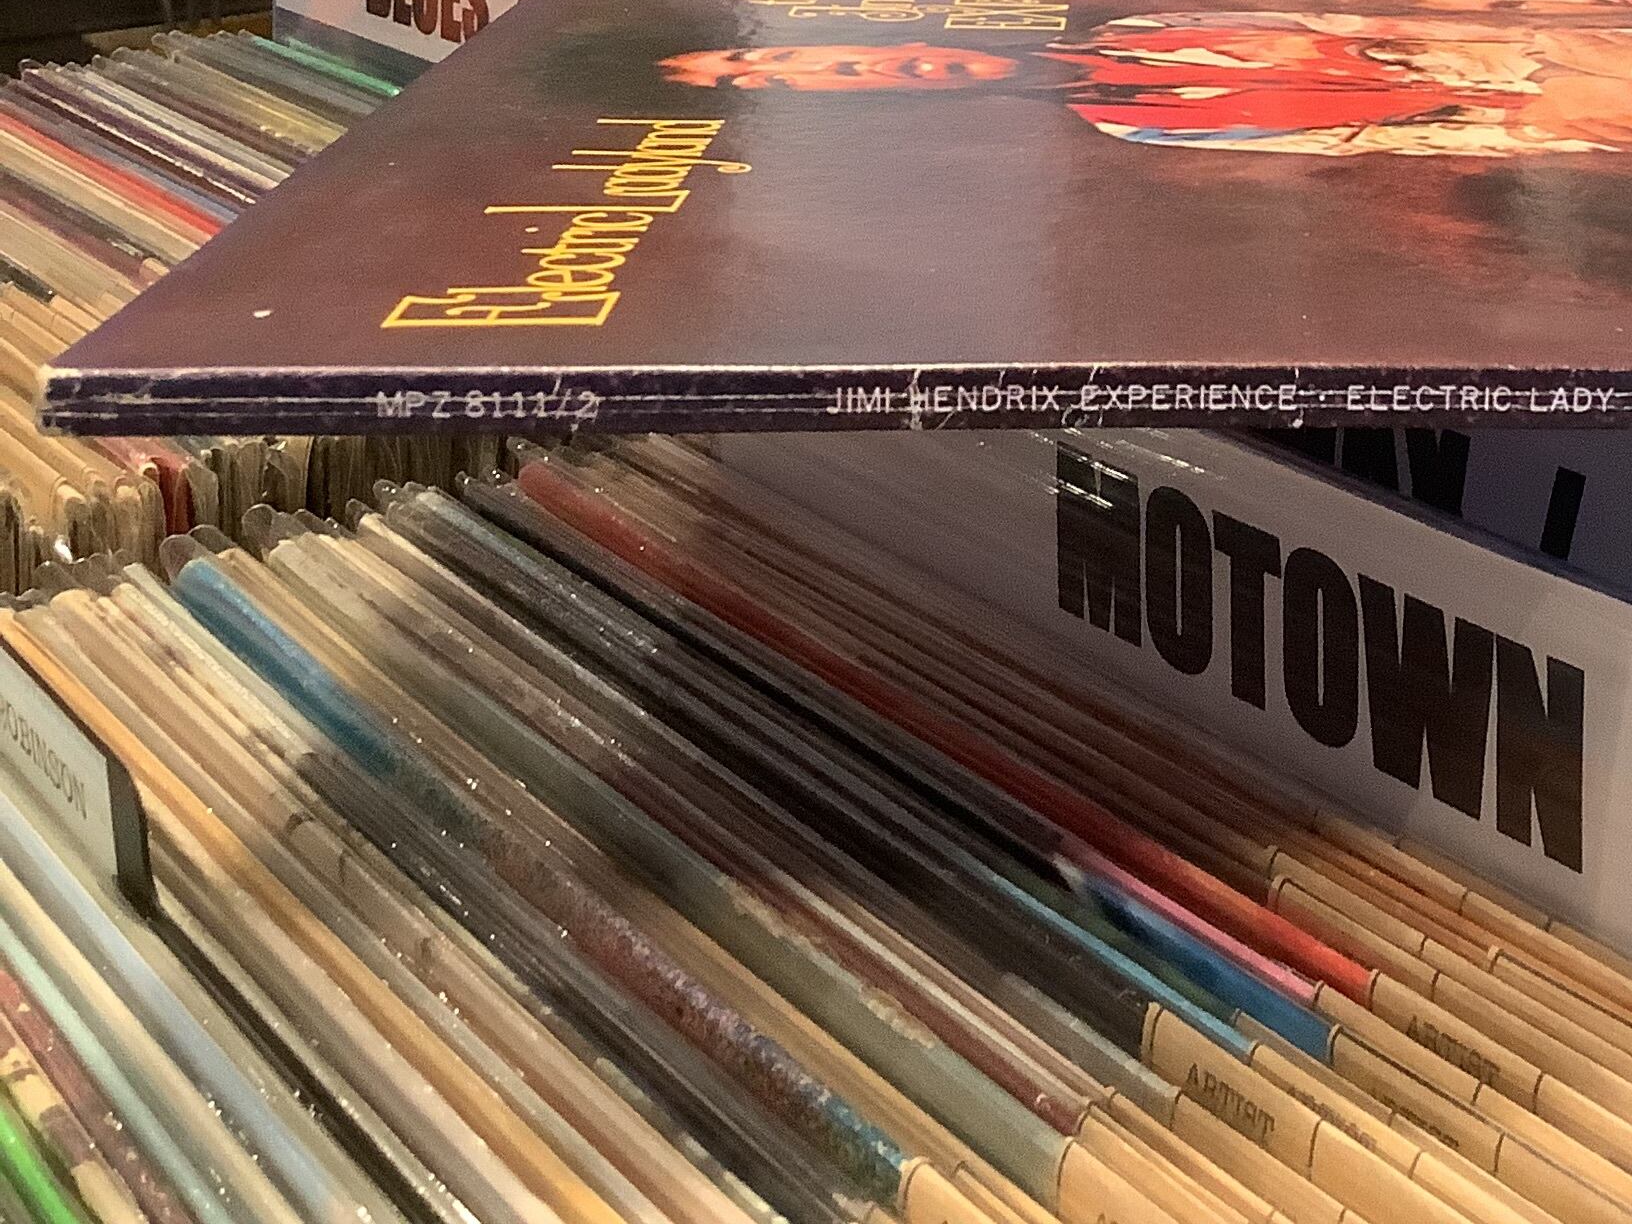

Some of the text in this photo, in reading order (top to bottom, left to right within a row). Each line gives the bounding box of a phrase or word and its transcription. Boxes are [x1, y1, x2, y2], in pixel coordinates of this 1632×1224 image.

[376, 388, 601, 420] MPZ 8111/2
[825, 386, 893, 414] JIMI
[908, 385, 1061, 414] HENDRIX
[1076, 384, 1300, 413] EXPERIENCE
[1346, 384, 1513, 412] ELECTRIC
[1529, 386, 1615, 414] LADY
[1056, 440, 1586, 875] MOTOWN
